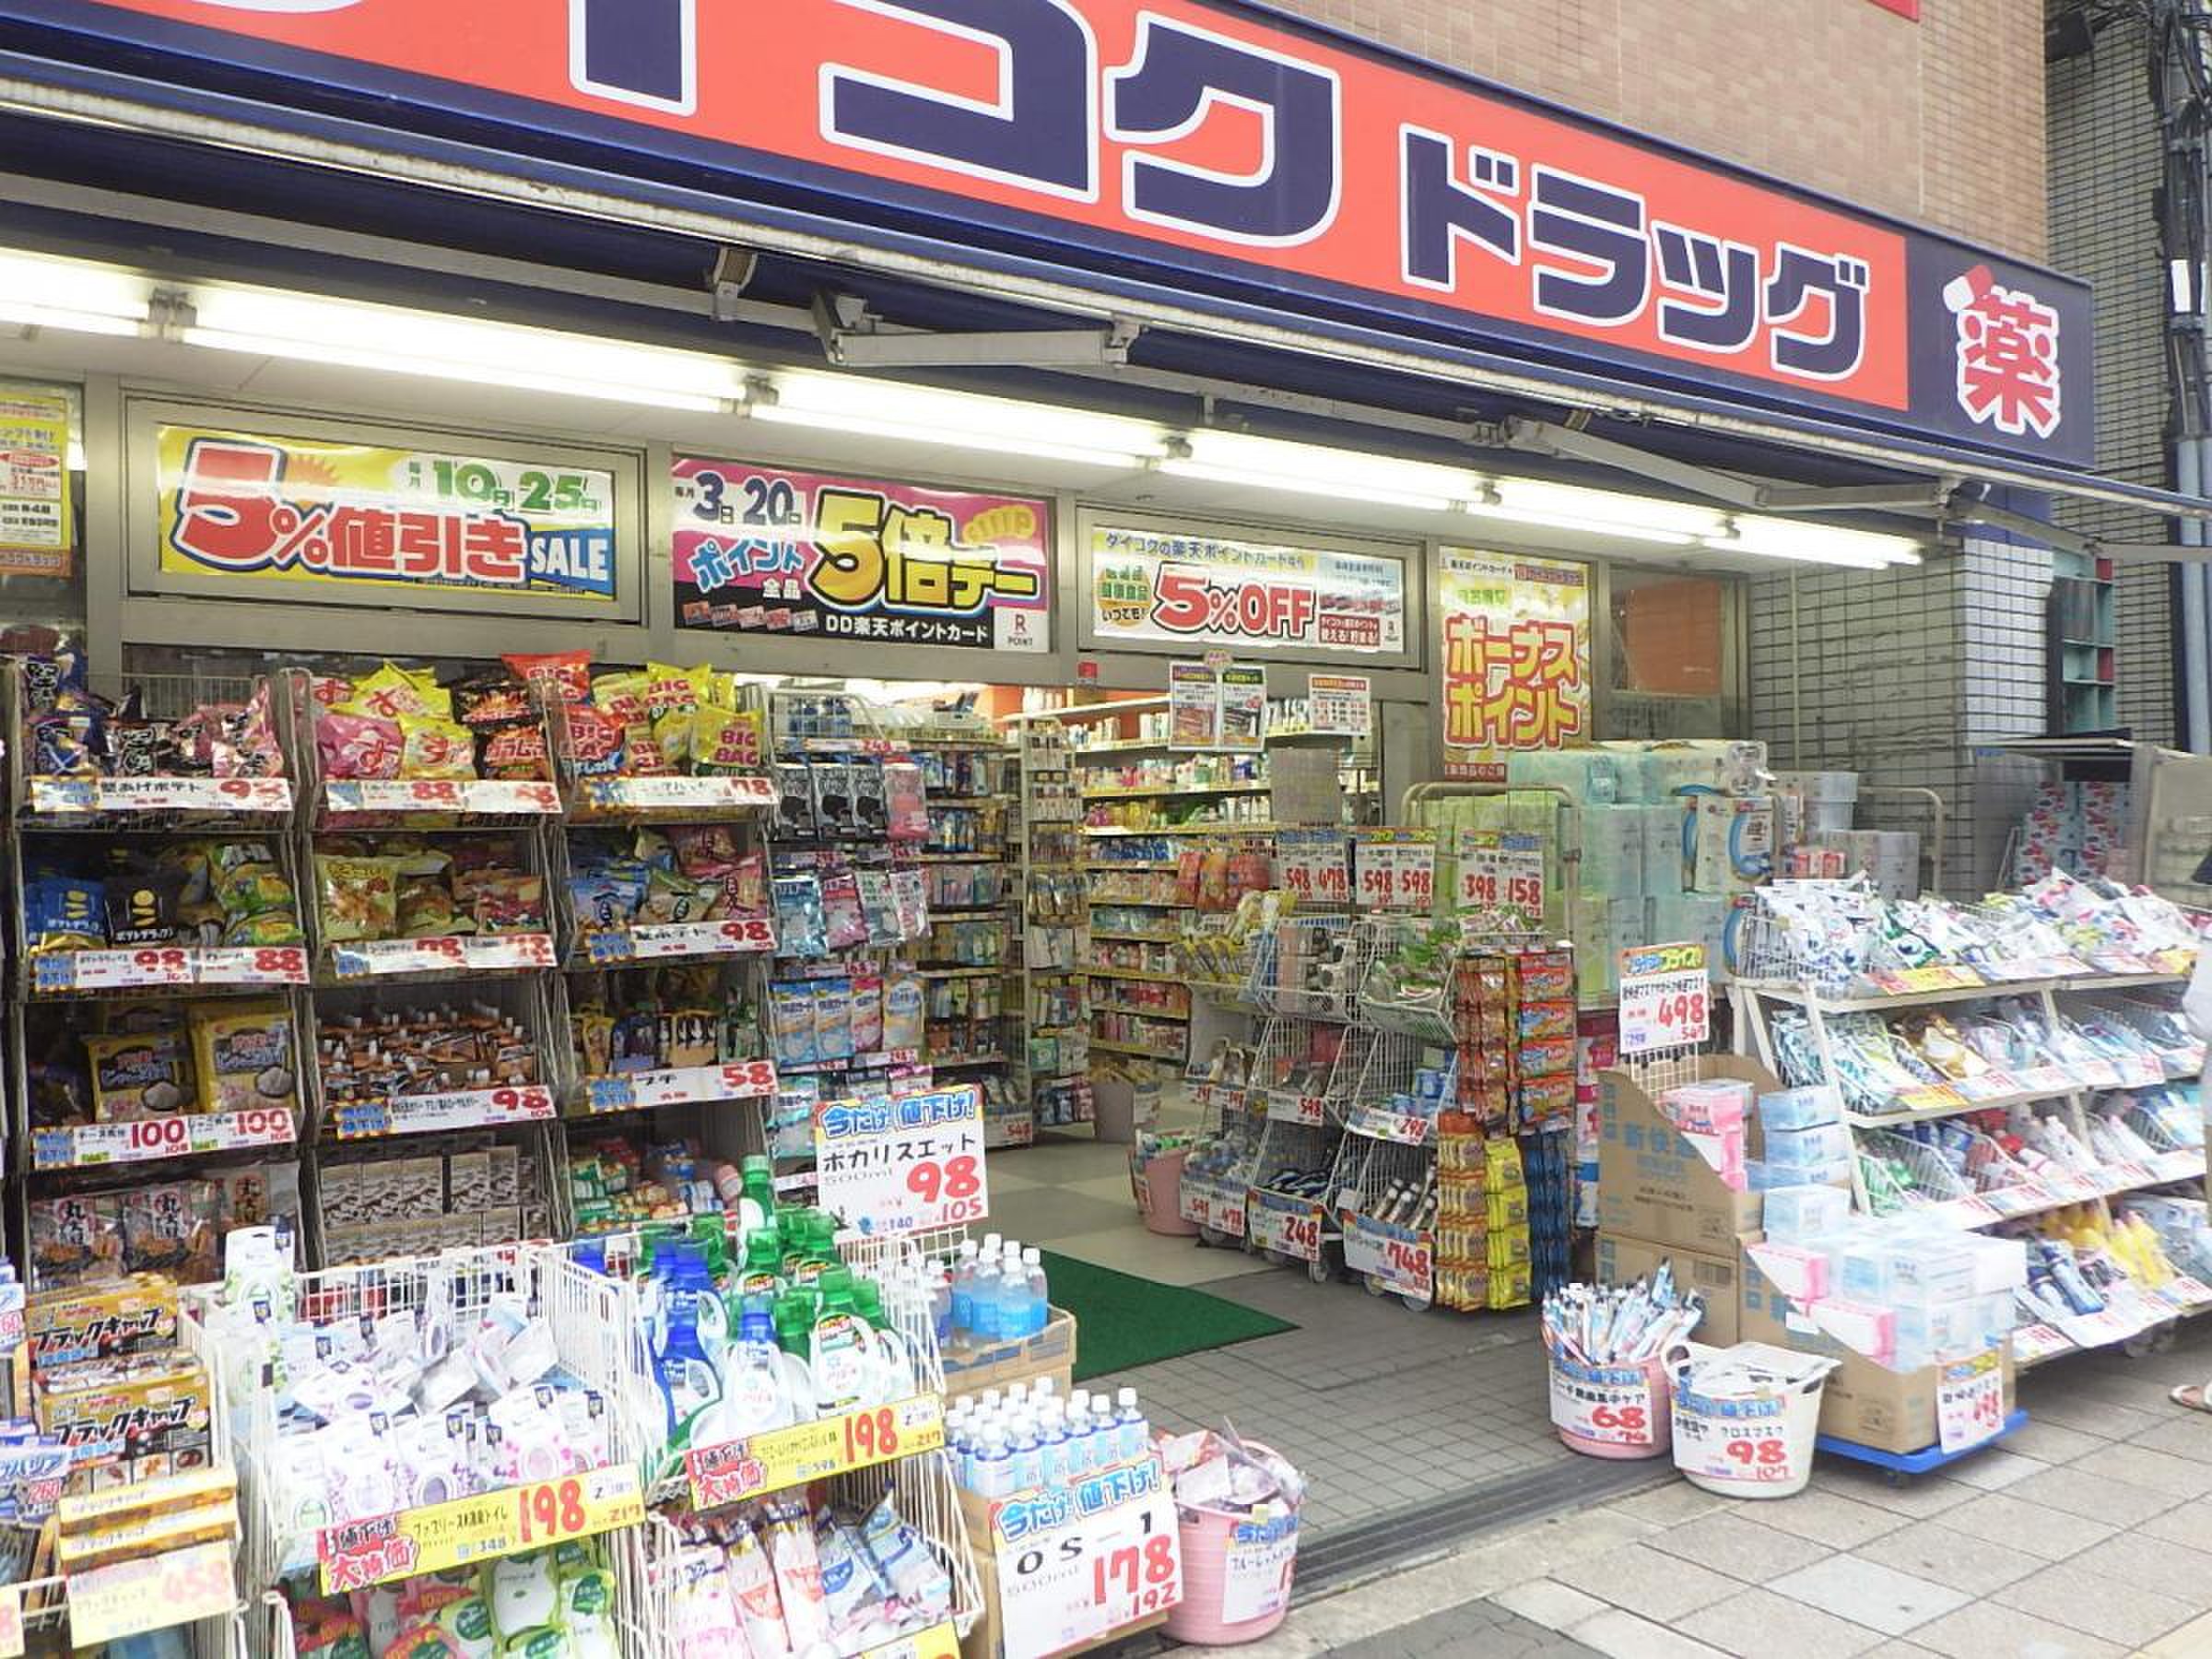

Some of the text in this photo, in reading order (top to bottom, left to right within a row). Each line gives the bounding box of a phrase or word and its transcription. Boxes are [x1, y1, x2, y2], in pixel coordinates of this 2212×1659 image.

[1398, 122, 1869, 382] ドラッグ
[1943, 264, 2063, 441] 薬
[170, 436, 529, 587] 5%値引き
[529, 535, 610, 582] SALE
[686, 535, 806, 593] ポイント
[1152, 564, 1316, 639] 5%OFF
[1446, 612, 1582, 689] ボーナス
[1446, 680, 1582, 749] ポイント
[1285, 867, 1312, 891] 598
[1362, 868, 1394, 893] 598
[1401, 868, 1430, 894] 598
[1464, 874, 1498, 902] 398
[1506, 877, 1542, 903] 158
[720, 922, 771, 941] 98
[254, 948, 304, 972] 88
[1657, 993, 1705, 1027] 498
[722, 1062, 775, 1087] 58
[491, 1089, 549, 1111] 98
[131, 1119, 186, 1148] 100
[236, 1109, 289, 1135] 100
[905, 1154, 981, 1204] 98
[941, 1197, 983, 1223] 105
[1283, 1216, 1319, 1248] 248
[1386, 1243, 1430, 1277] 748
[1591, 1406, 1647, 1430] 68
[843, 1406, 900, 1464] 198
[1725, 1439, 1788, 1465] 98
[518, 1478, 586, 1545] 198
[1093, 1533, 1175, 1606] 178
[1132, 1581, 1177, 1618] 192
